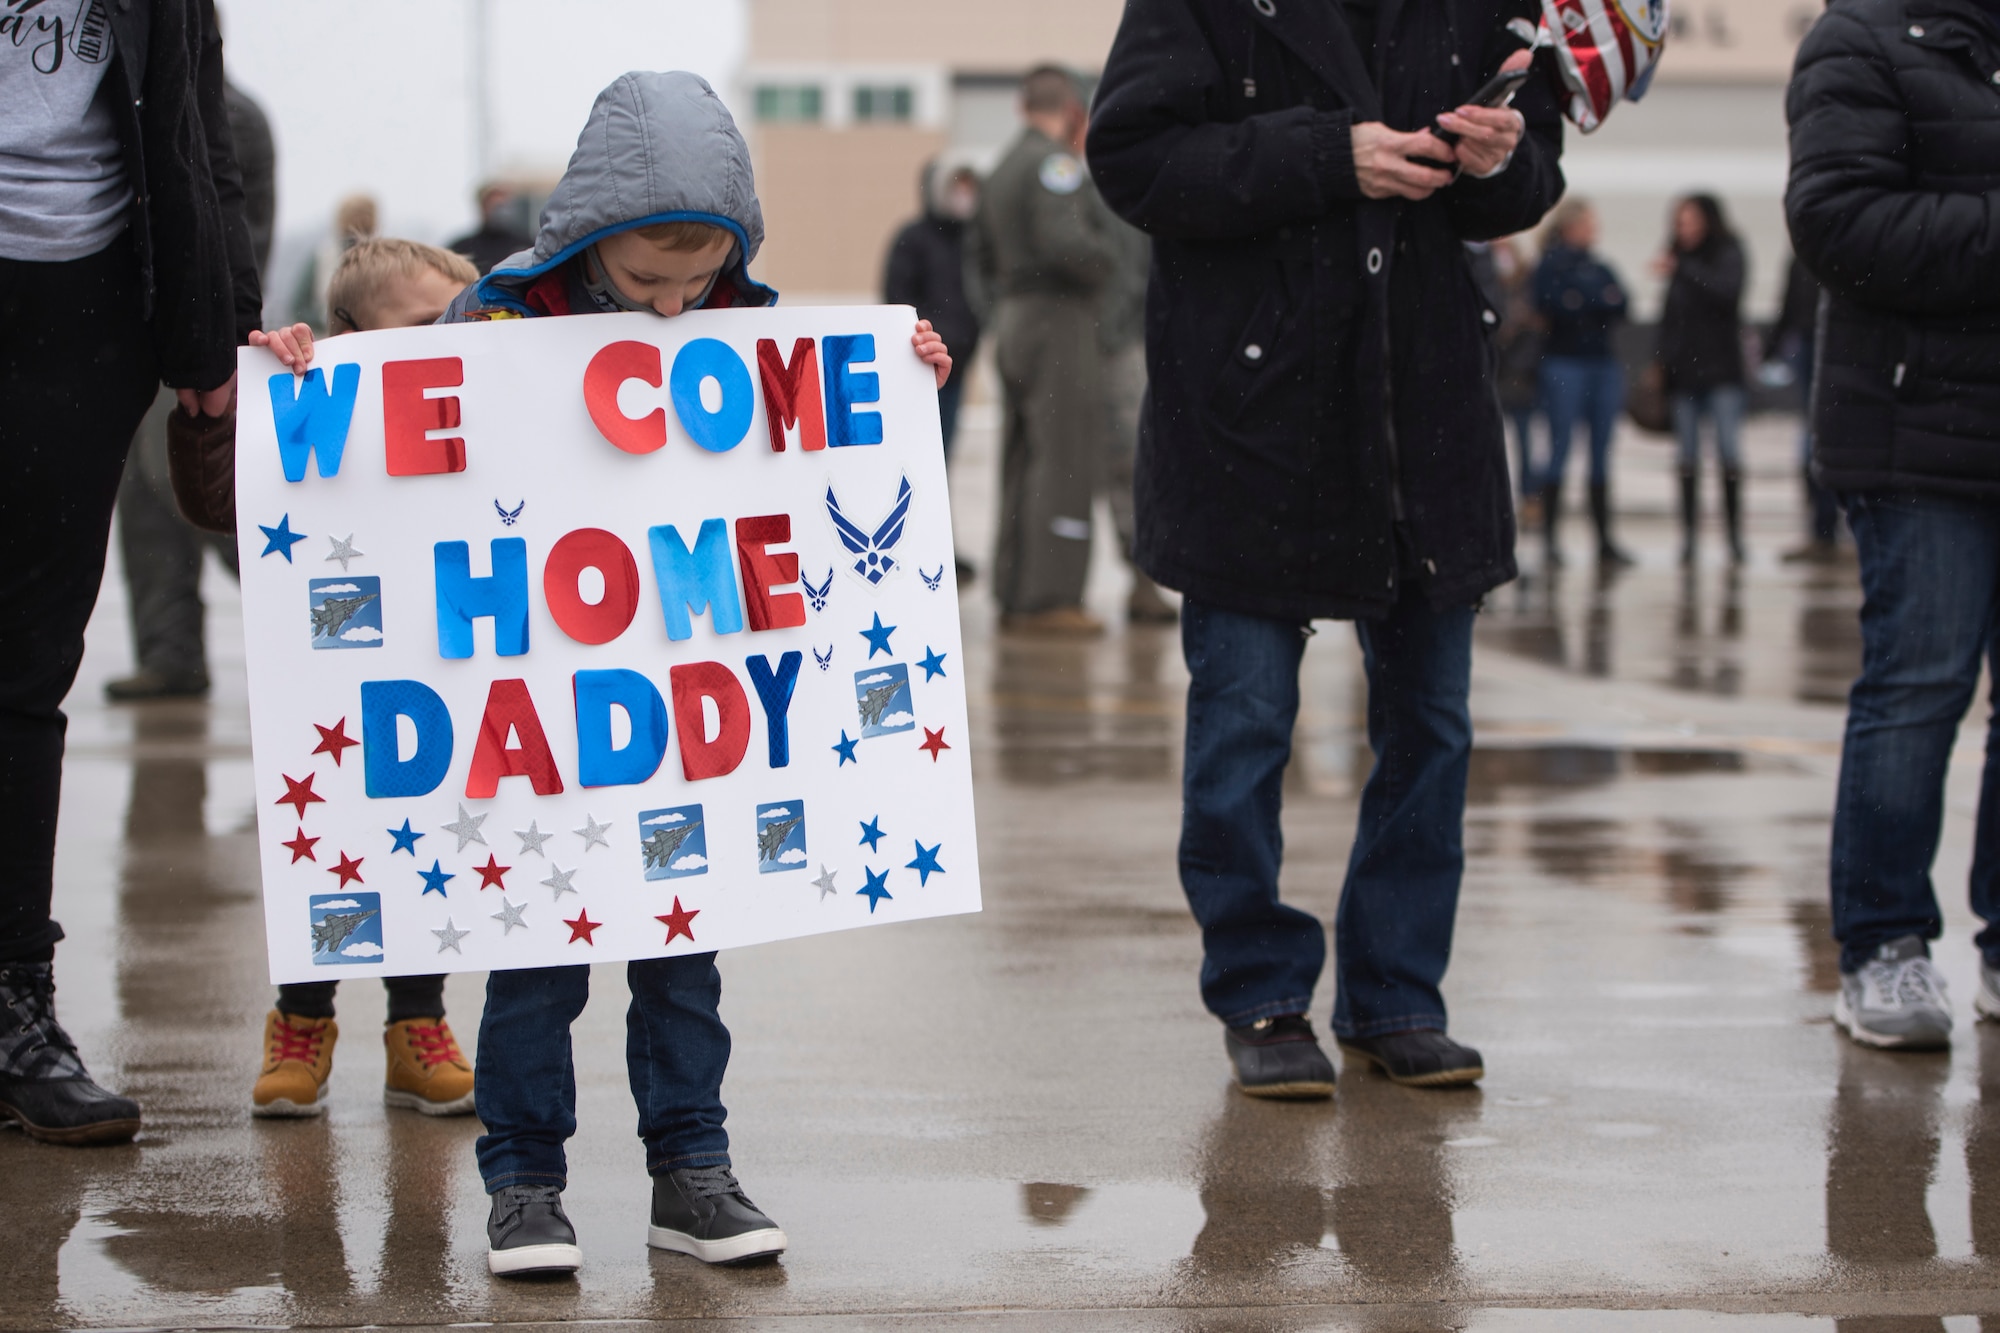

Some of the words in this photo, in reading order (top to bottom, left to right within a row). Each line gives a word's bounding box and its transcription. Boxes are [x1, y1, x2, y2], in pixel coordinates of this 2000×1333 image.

[268, 357, 467, 483] WE
[584, 333, 884, 455] COME
[434, 514, 807, 660] HOME
[361, 651, 803, 799] DADDY
